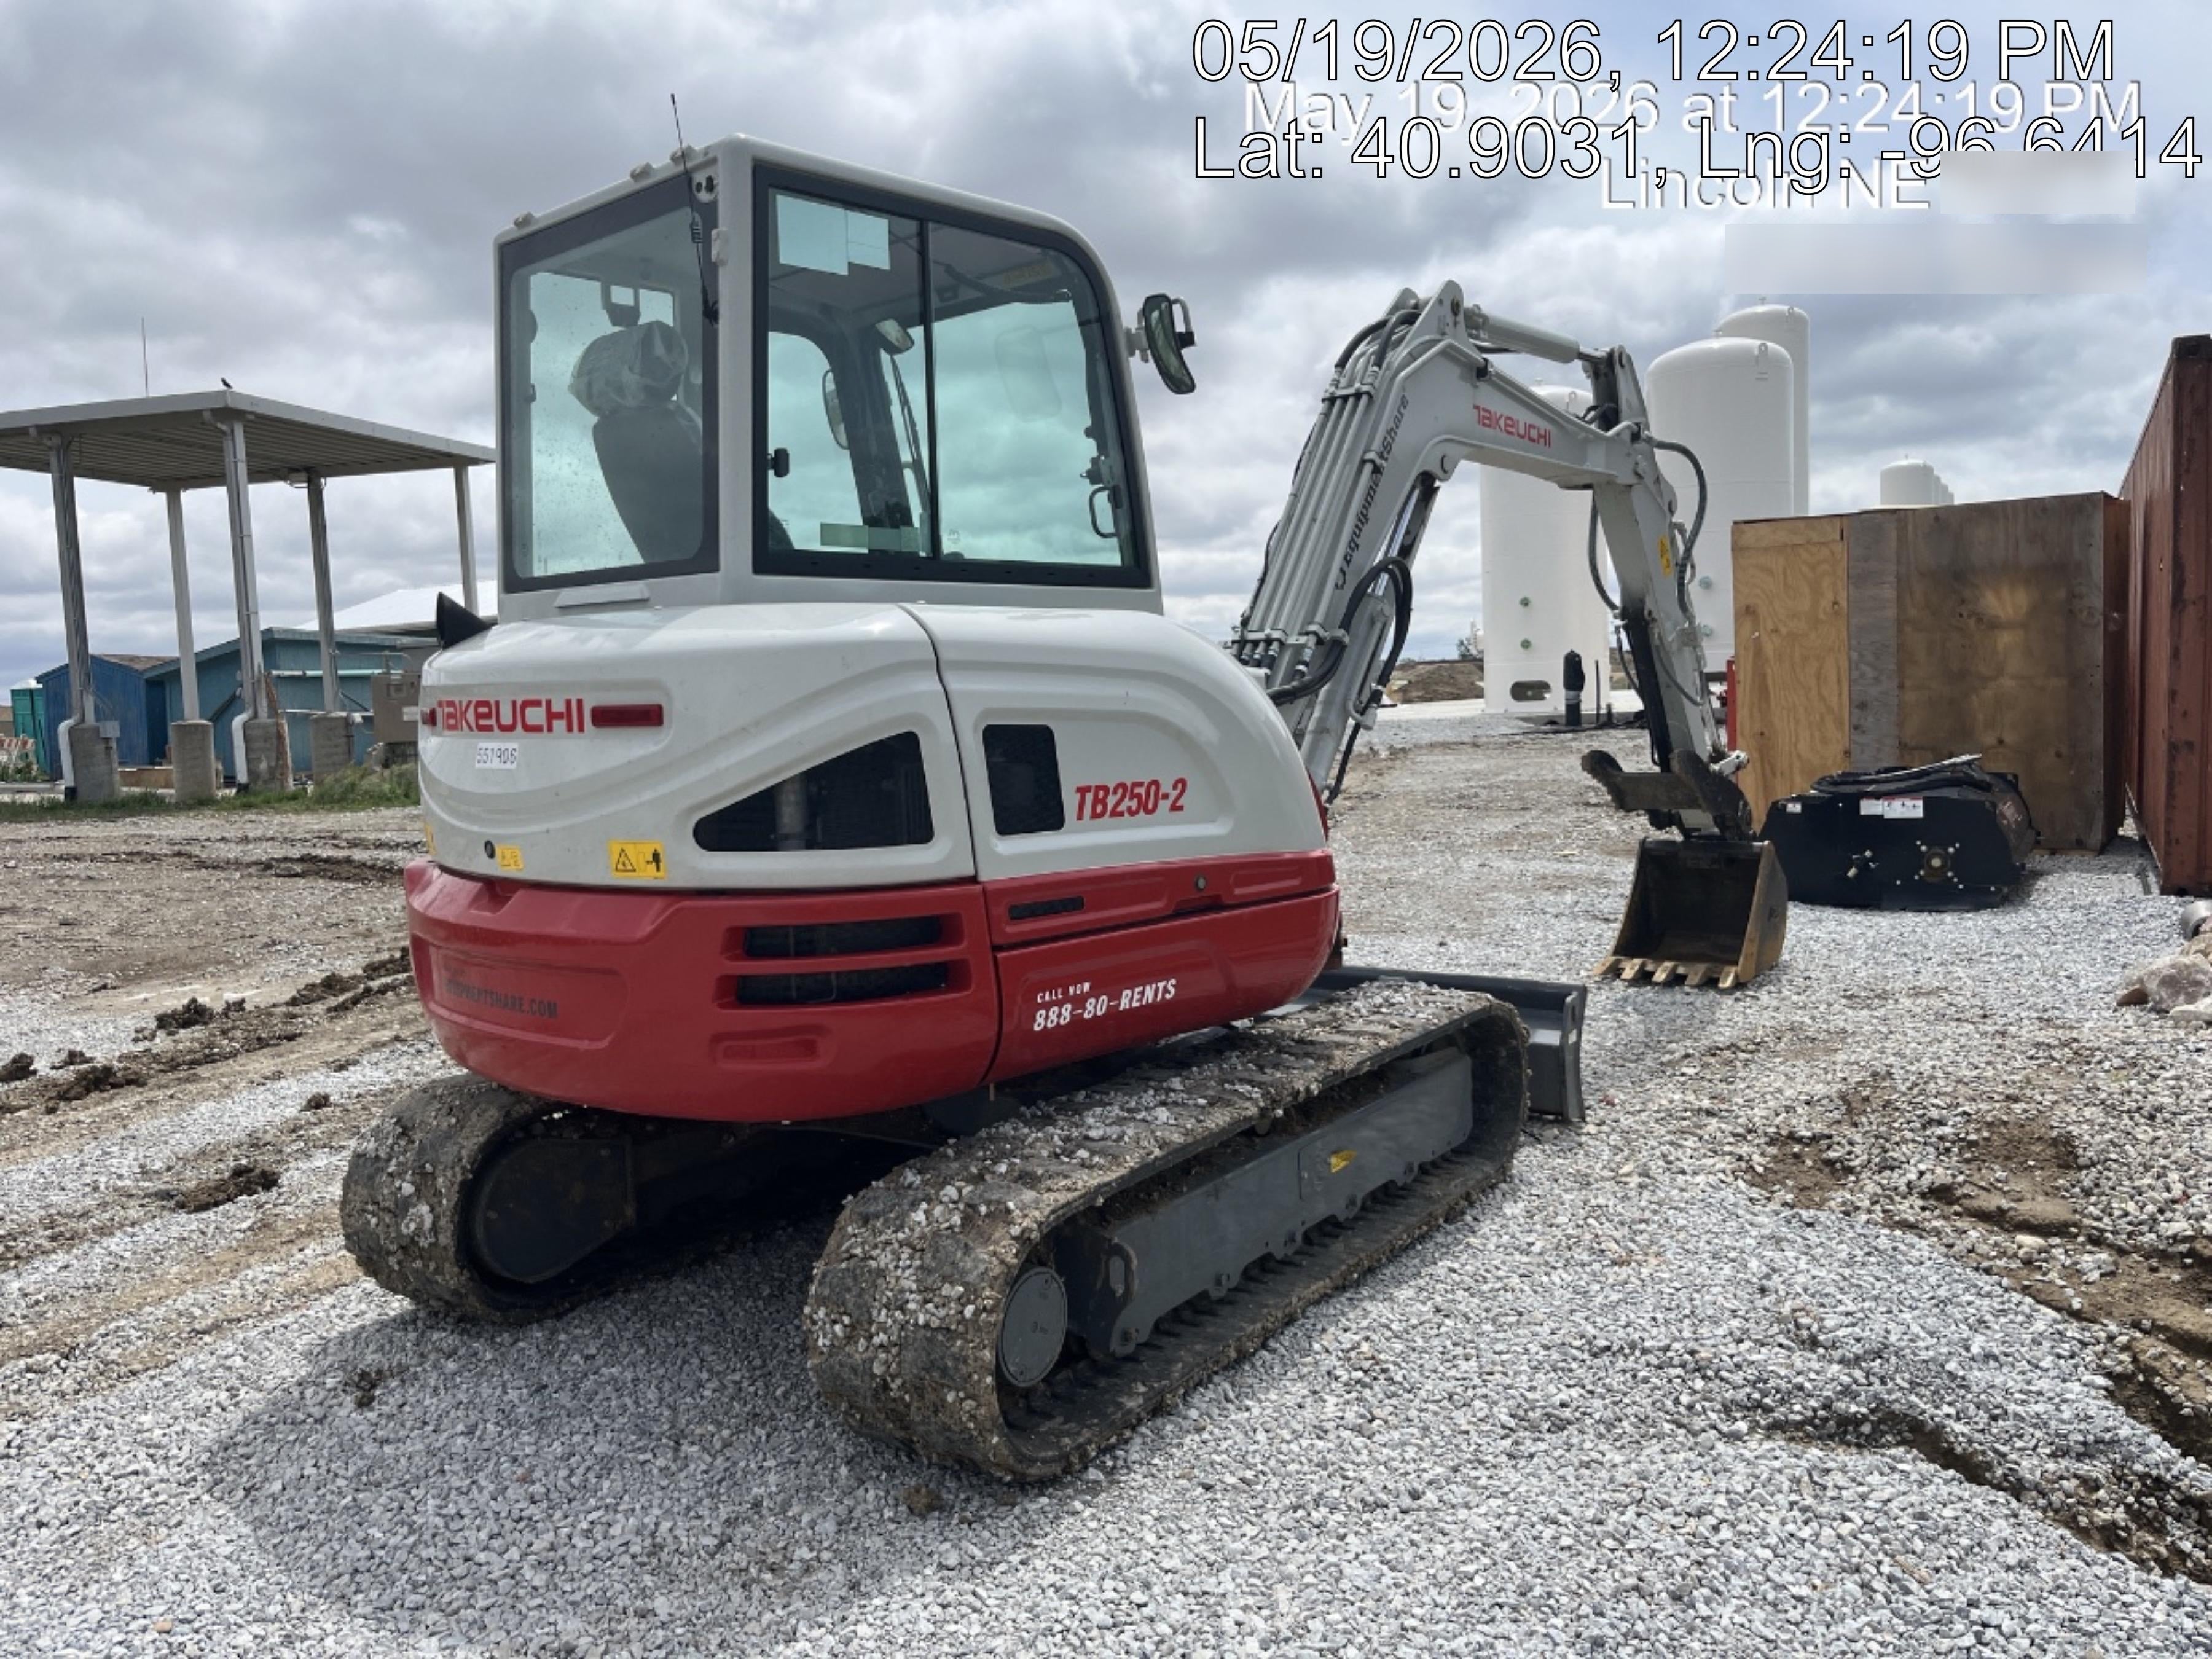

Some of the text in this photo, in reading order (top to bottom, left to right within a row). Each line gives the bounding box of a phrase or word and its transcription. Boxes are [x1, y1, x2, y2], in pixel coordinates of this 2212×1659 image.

[1075, 777, 1188, 822] TB250-2
[1033, 978, 1177, 1032] 888-80-RENTS
[1037, 982, 1092, 1003] CALL NOW
